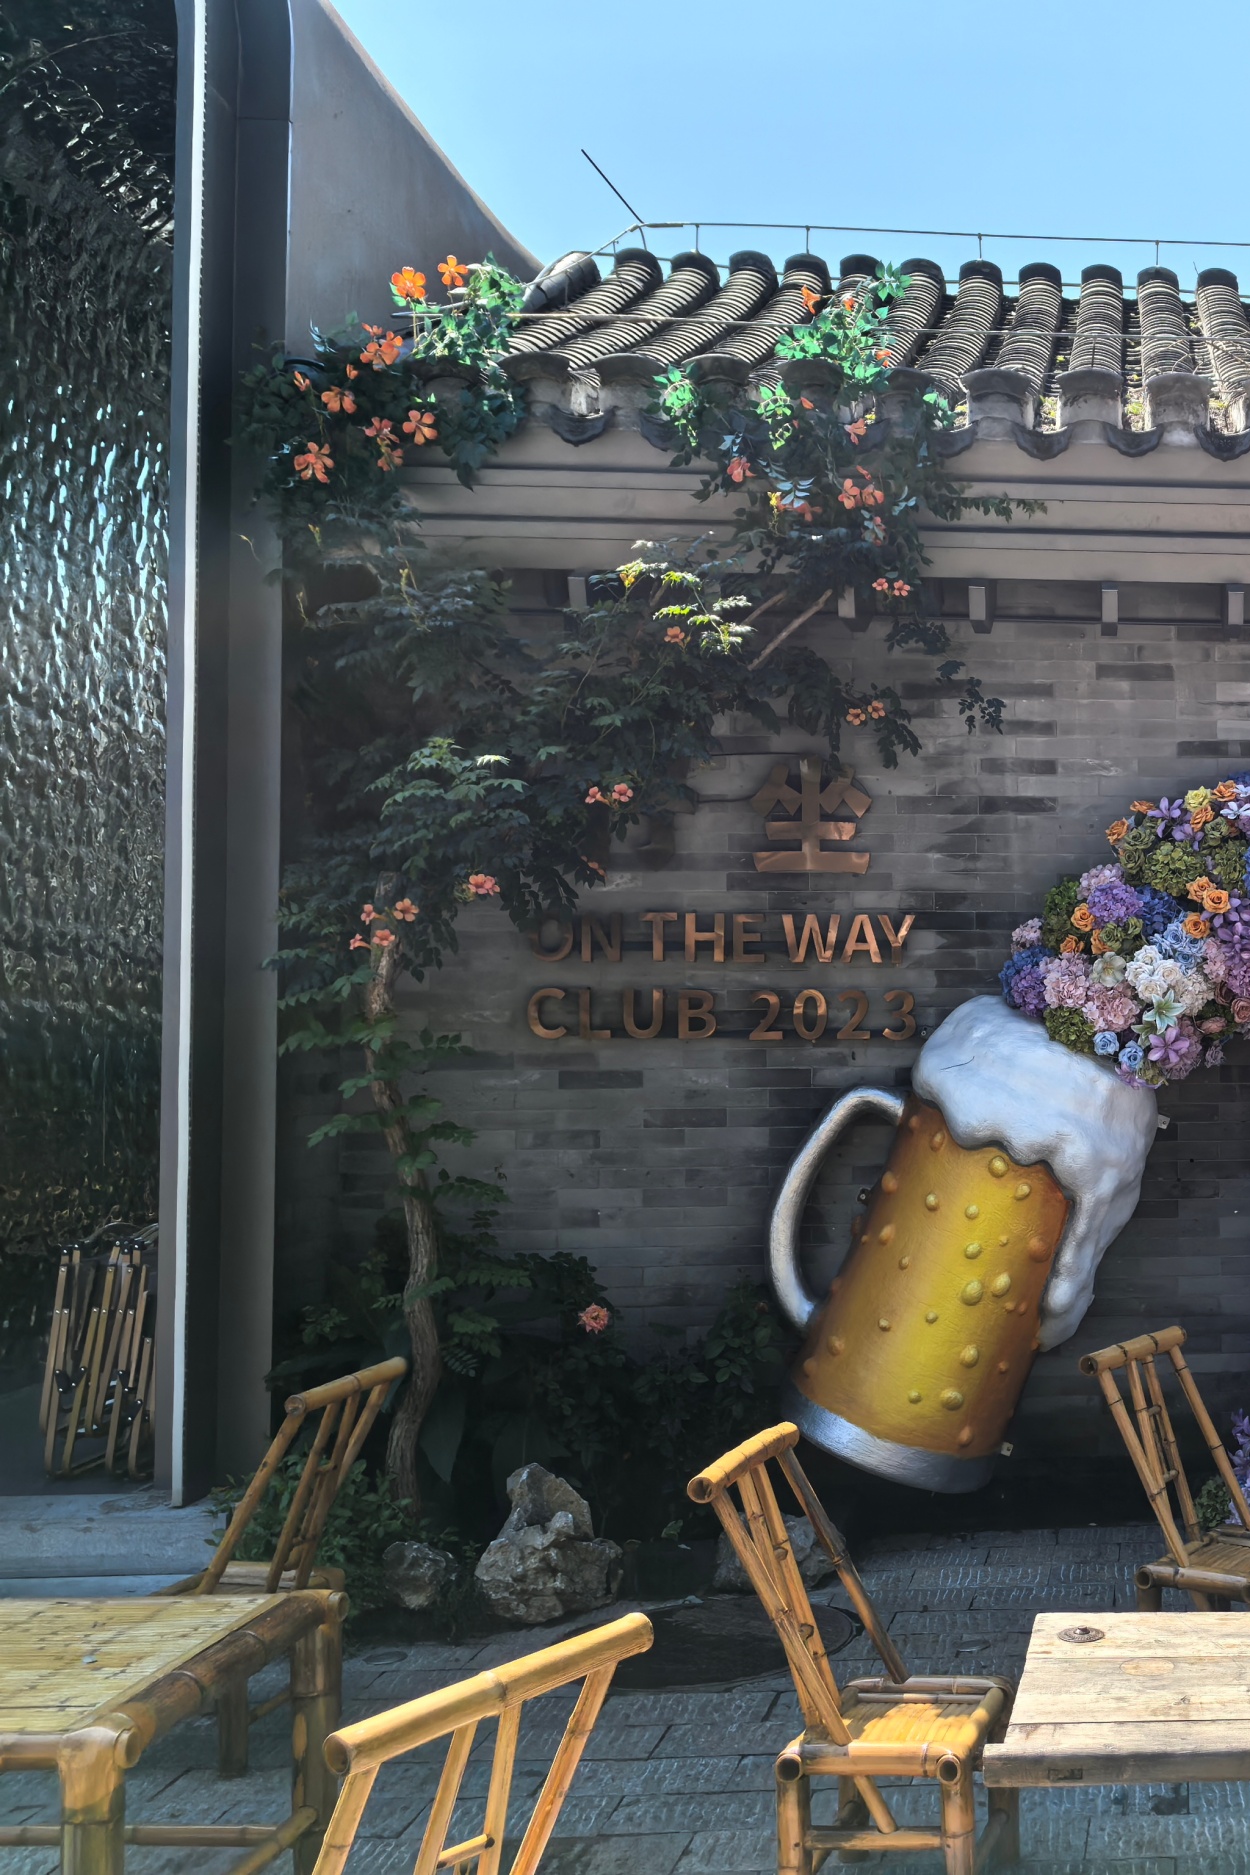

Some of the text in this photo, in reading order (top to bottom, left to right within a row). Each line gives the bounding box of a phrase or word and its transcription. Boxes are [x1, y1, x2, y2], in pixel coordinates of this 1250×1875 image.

[528, 911, 916, 965] ON THE WAY
[527, 987, 917, 1041] CLUB 2023
